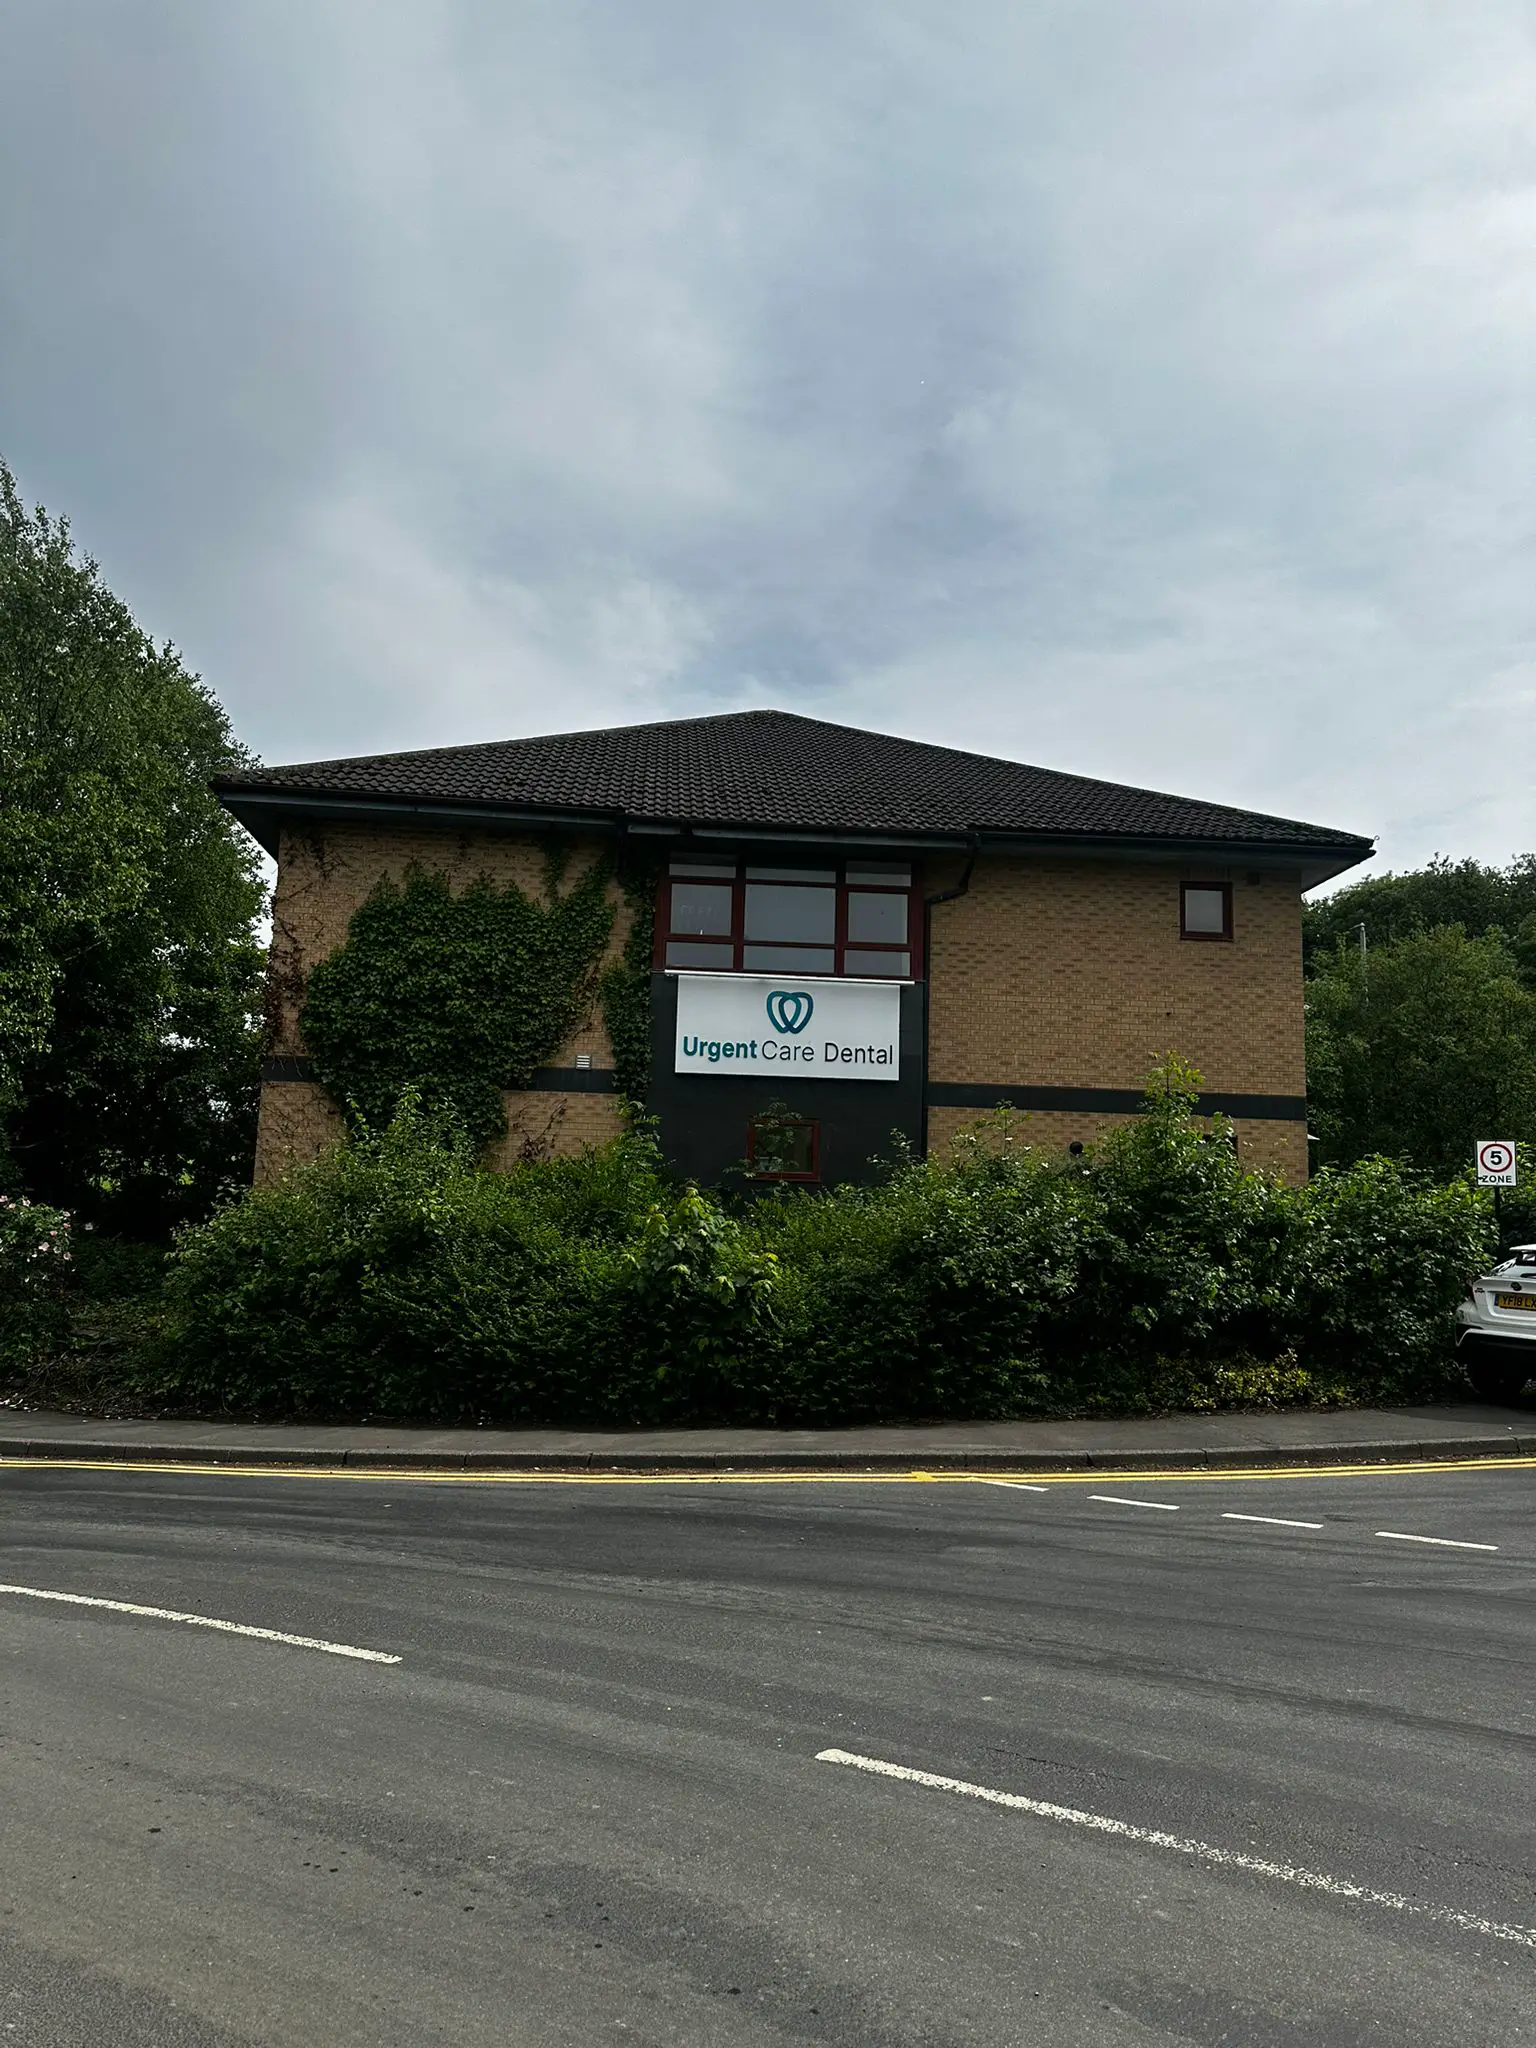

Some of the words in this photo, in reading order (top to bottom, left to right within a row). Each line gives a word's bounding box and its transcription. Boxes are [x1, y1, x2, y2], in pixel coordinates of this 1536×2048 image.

[824, 1042, 893, 1065] Dental
[1490, 1151, 1502, 1165] 5
[1482, 1175, 1512, 1183] ZONE
